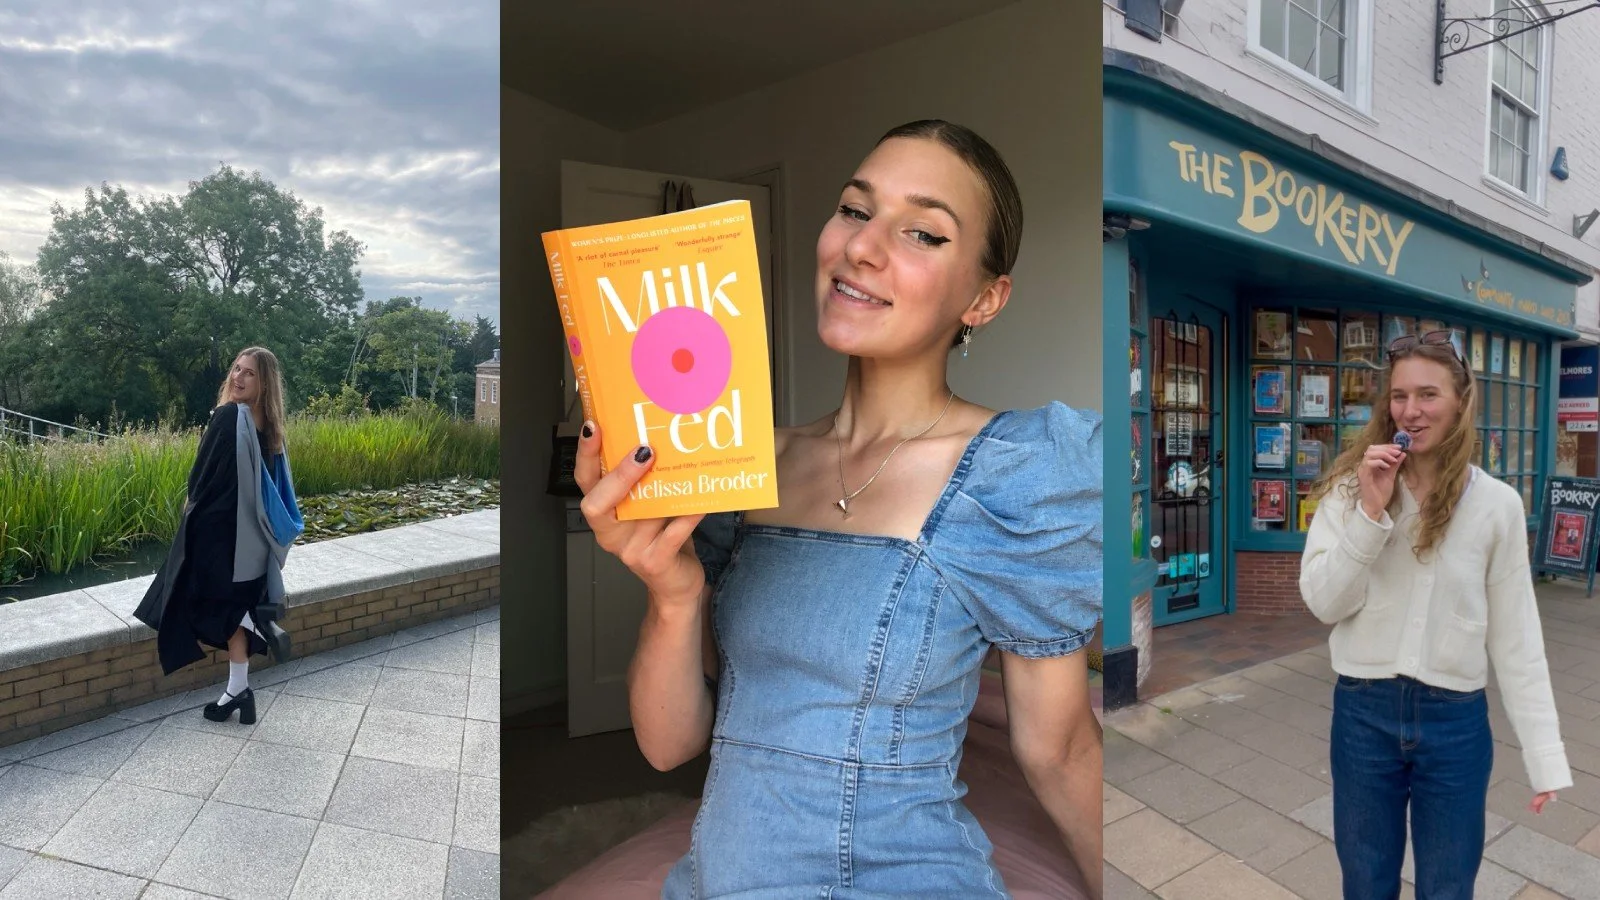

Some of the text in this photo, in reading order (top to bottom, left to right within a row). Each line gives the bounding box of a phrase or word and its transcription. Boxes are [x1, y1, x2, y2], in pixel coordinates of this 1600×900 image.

[1168, 140, 1415, 276] THE BOOKERY
[670, 223, 698, 234] AUTHOR
[698, 222, 707, 230] OF
[709, 219, 721, 227] THE
[600, 250, 607, 258] of
[549, 251, 564, 289] Milk
[596, 262, 742, 335] Milk
[1560, 366, 1593, 376] ELMORES
[633, 388, 743, 454] Fed
[628, 470, 769, 501] Melissa Broder
[1551, 489, 1600, 510] BOOKERY
